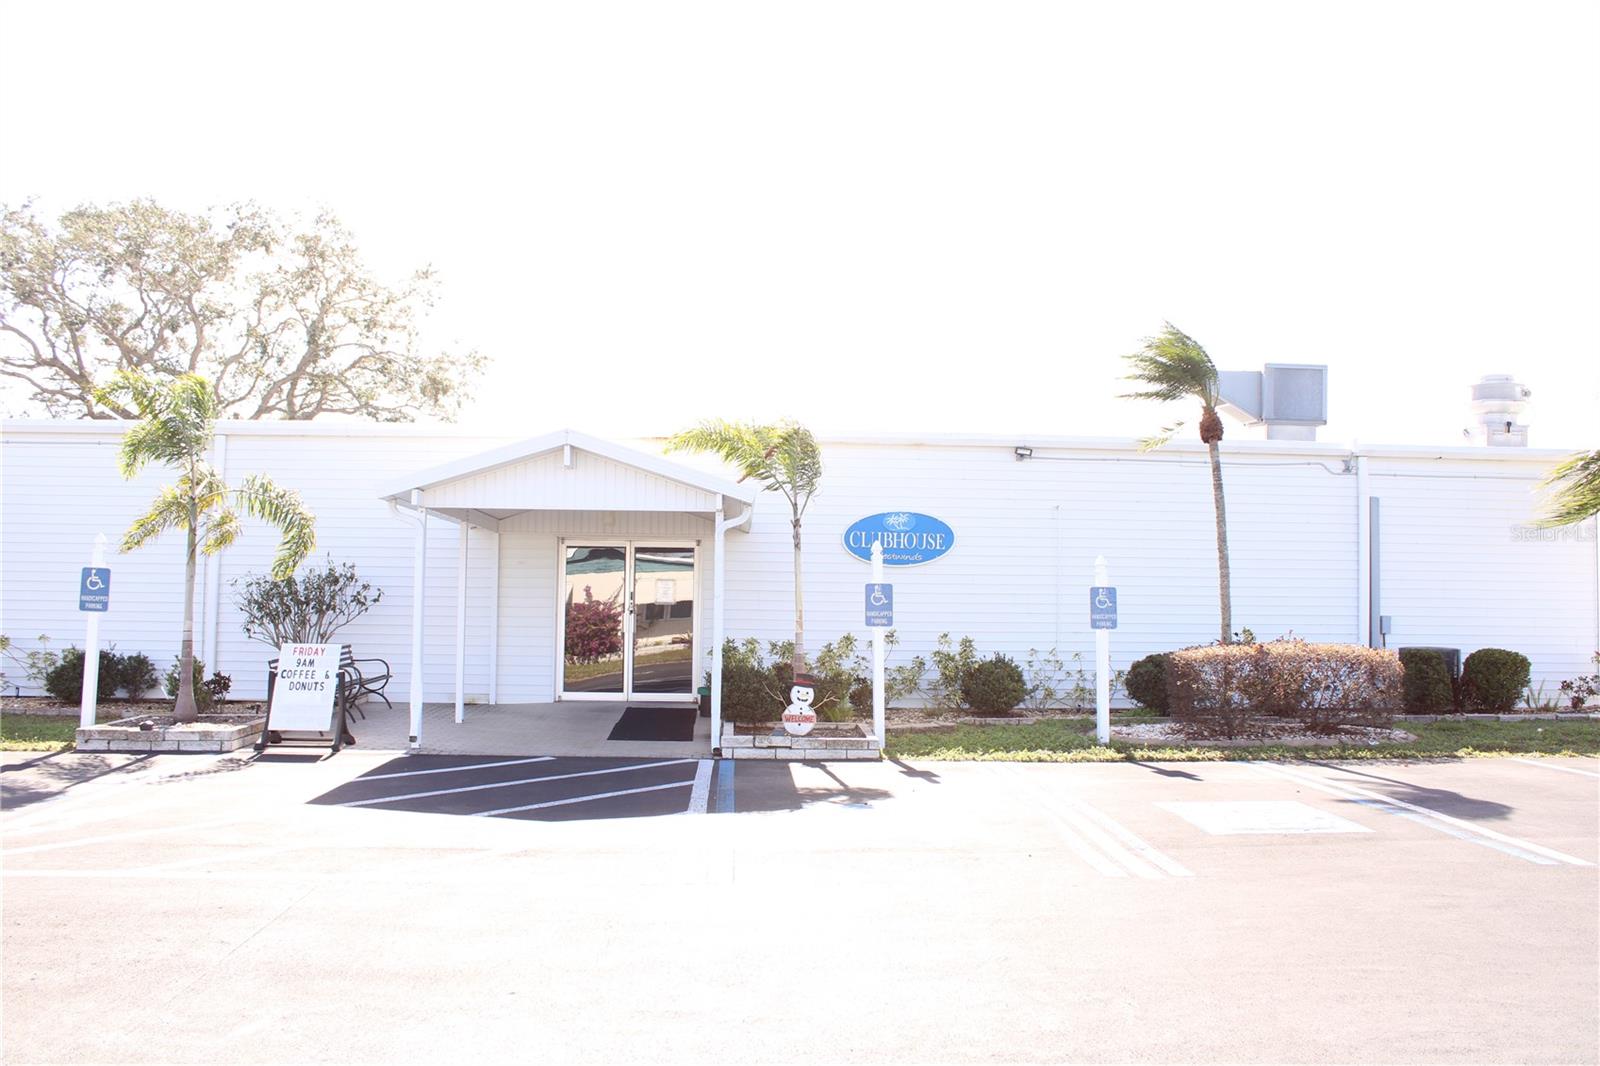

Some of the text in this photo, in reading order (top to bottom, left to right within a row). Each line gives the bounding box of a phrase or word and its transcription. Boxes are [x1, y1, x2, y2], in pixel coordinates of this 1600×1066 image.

[849, 529, 946, 550] CLUBHOUSE
[293, 647, 326, 656] FRIDAY
[296, 659, 315, 668] 9AM
[281, 669, 316, 679] COFFEE
[289, 681, 325, 691] DONUTS
[784, 714, 815, 723] WELCOME
